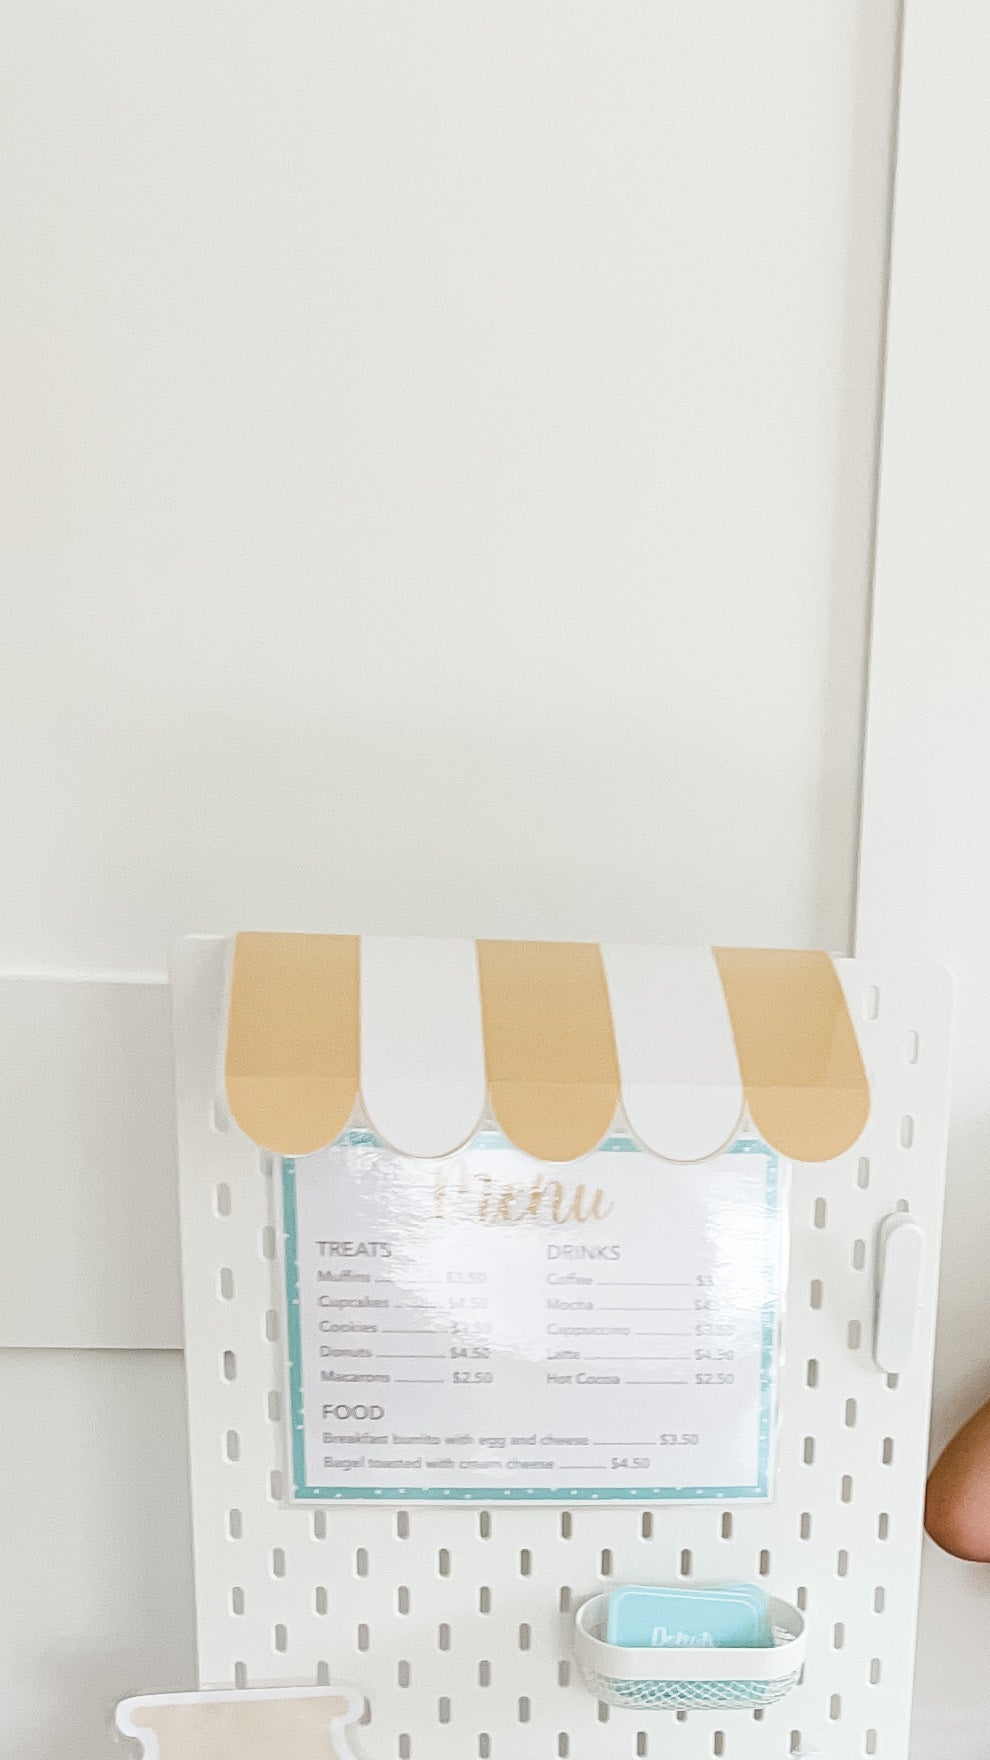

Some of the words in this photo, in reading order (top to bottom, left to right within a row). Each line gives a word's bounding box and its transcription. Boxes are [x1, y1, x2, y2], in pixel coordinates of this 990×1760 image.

[315, 1240, 392, 1258] TREATS
[547, 1245, 621, 1261] DRINKS
[317, 1270, 371, 1283] Muffins
[546, 1273, 593, 1285] Coffee
[318, 1296, 390, 1310] Cupcakes
[546, 1299, 594, 1311] Mocha
[318, 1320, 378, 1333] Cookies
[319, 1345, 373, 1358] Donuts
[450, 1347, 491, 1359] $4.50
[320, 1370, 391, 1384] Macarons
[452, 1371, 494, 1384] $2.50
[546, 1373, 573, 1385] Hot
[576, 1372, 621, 1385] Cocoa
[694, 1373, 735, 1385] $2.50
[322, 1405, 385, 1420] FOOD
[322, 1432, 388, 1444] Breakfast
[391, 1433, 440, 1444] burrito
[445, 1434, 474, 1445] with
[479, 1437, 506, 1448] egg
[510, 1434, 537, 1446] and
[540, 1434, 589, 1446] cheese
[660, 1434, 699, 1445] $3.50
[323, 1456, 365, 1471] Bagel
[367, 1457, 422, 1469] toasted
[426, 1458, 456, 1469] with
[506, 1458, 555, 1470] cheese
[611, 1457, 650, 1470] $4.50
